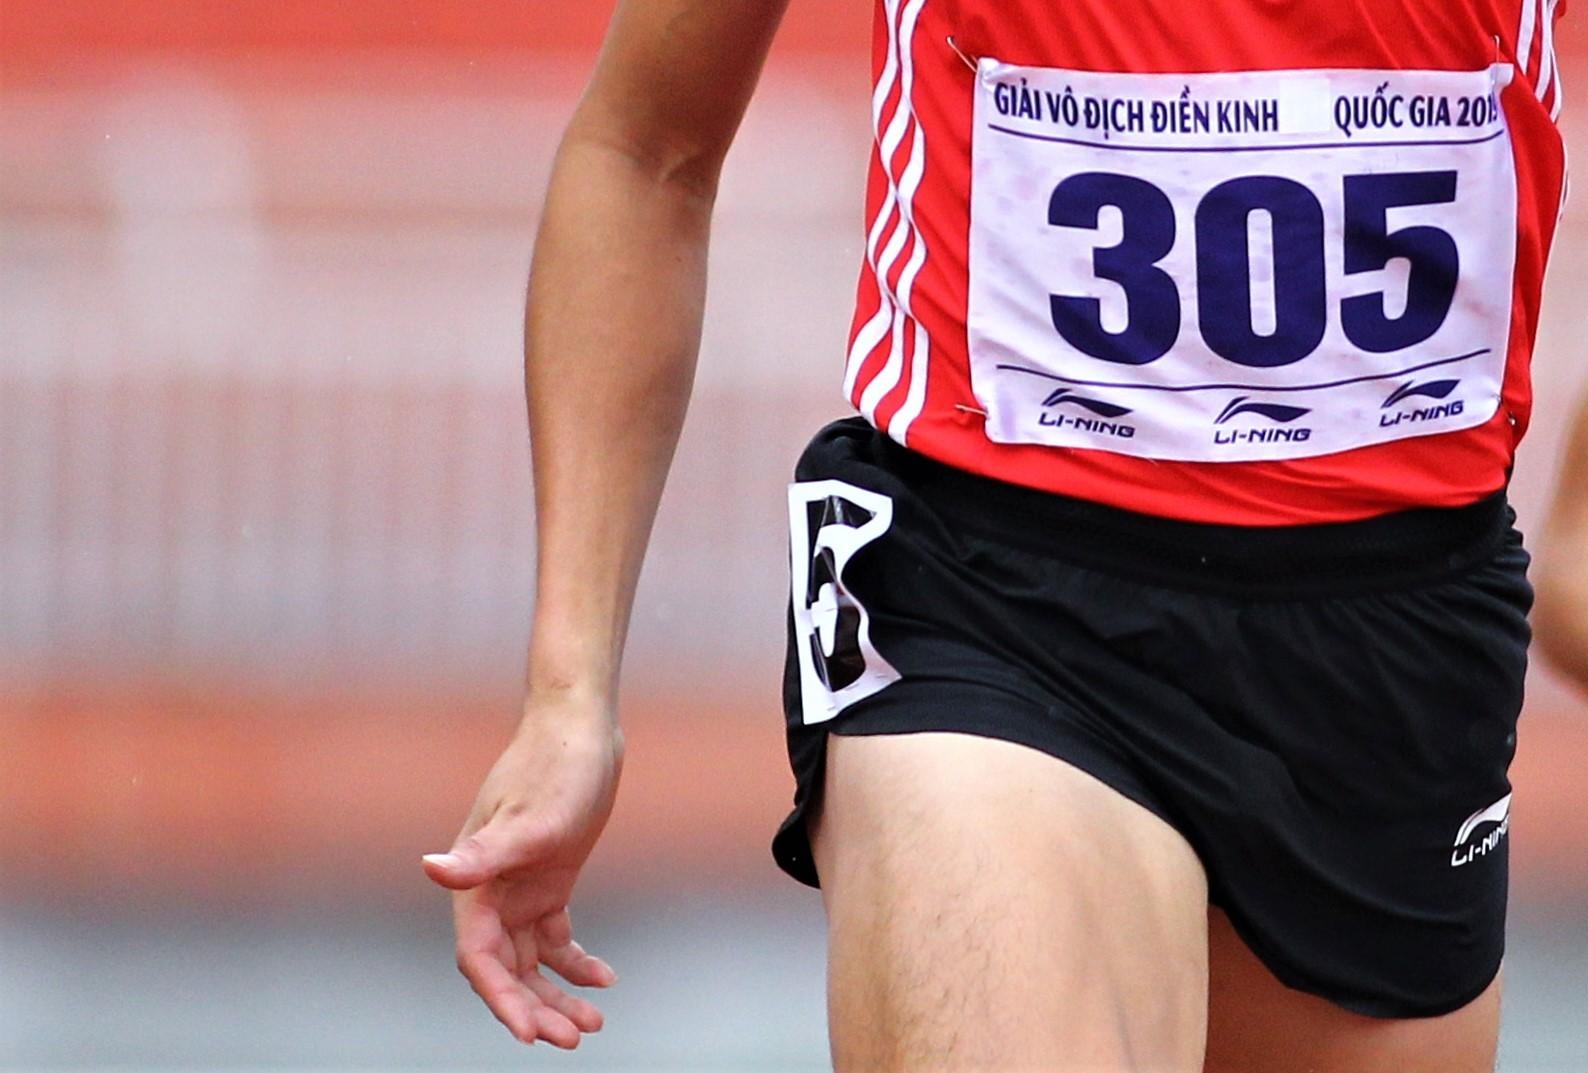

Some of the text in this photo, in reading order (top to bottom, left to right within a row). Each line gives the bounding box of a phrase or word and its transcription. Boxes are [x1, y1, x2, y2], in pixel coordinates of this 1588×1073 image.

[994, 77, 1041, 121] GIẢI
[1045, 85, 1079, 127] VÔ
[1084, 97, 1144, 140] ĐỊCH
[1151, 84, 1210, 133] ĐIỀN
[1217, 99, 1279, 133] KINH
[1334, 81, 1404, 138] QUỐC
[1409, 95, 1451, 127] GIA
[1047, 170, 1459, 368] 305
[1038, 413, 1136, 438] LI-NING
[1379, 400, 1464, 428] LI-NING
[1214, 428, 1312, 444] LI-NING
